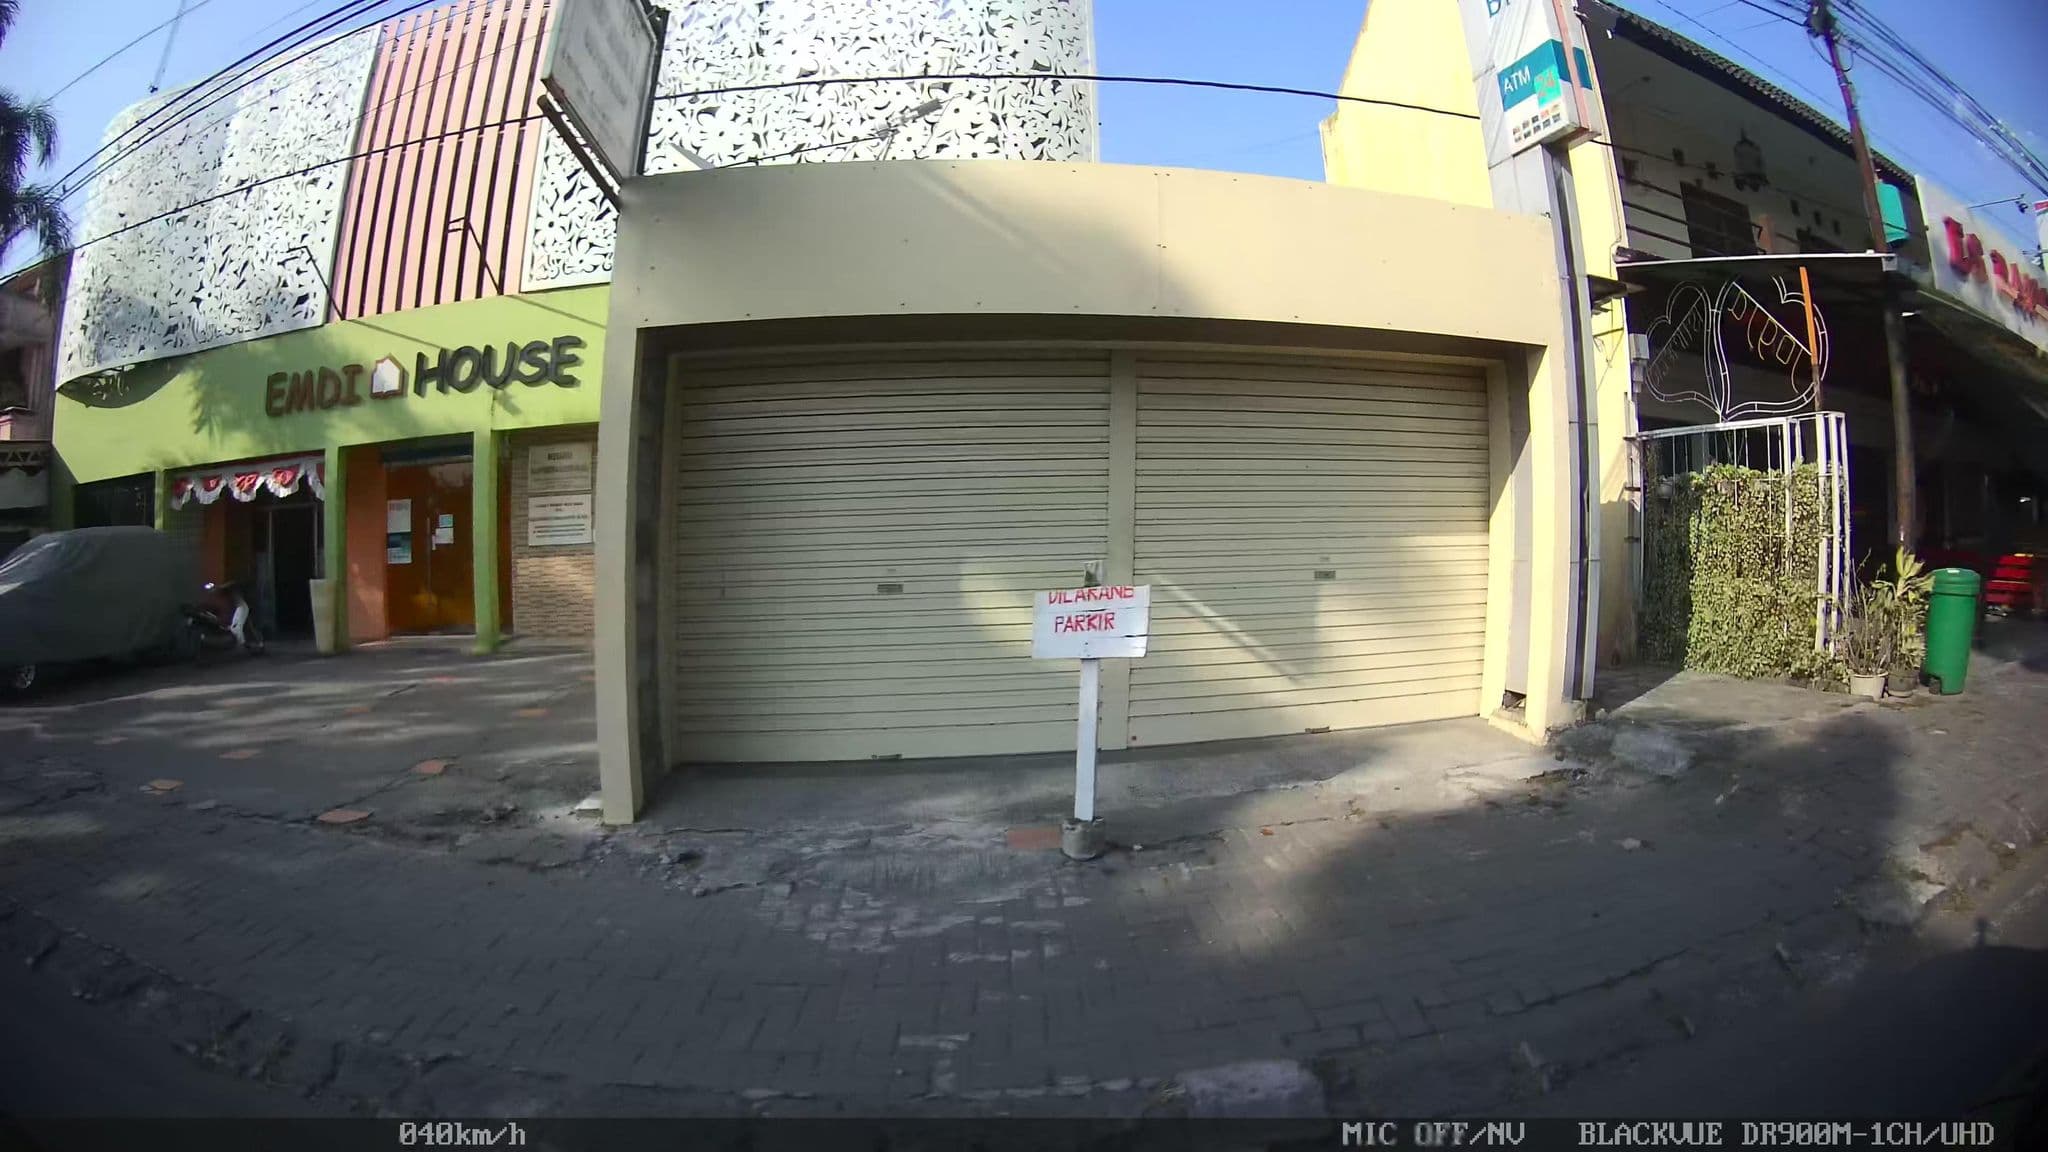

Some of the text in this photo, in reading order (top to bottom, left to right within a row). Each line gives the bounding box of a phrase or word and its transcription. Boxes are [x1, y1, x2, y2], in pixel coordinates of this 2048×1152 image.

[1504, 65, 1531, 94] ATM
[265, 335, 586, 417] EMDI HOUSE
[1055, 611, 1115, 633] PARKIR
